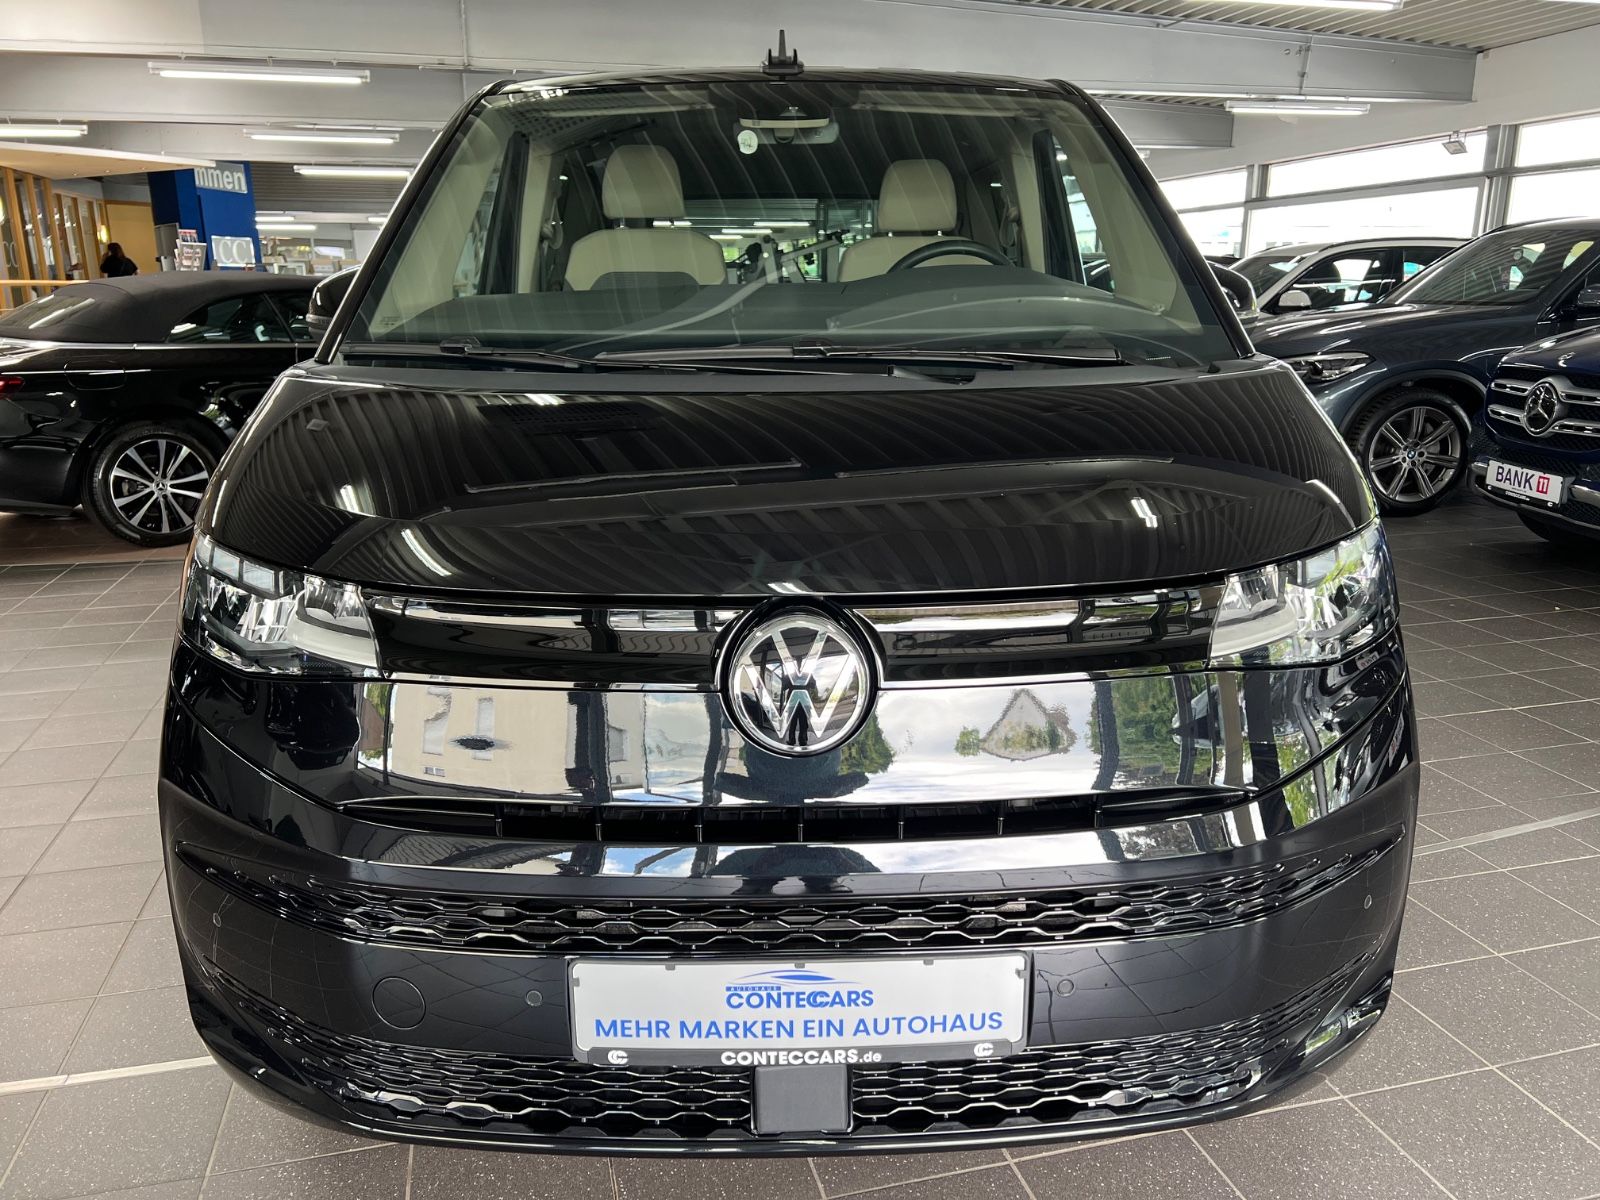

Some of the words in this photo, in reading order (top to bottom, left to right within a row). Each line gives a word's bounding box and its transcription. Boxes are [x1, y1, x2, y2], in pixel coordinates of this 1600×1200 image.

[219, 240, 248, 264] CC
[1495, 466, 1535, 491] BANK
[735, 618, 862, 745] VW
[725, 989, 875, 1009] CONTECCARS
[595, 1019, 671, 1039] MEHR
[679, 1019, 794, 1039] MARKEN
[803, 1018, 844, 1038] EIN
[852, 1011, 1003, 1037] AUTOHAUS
[720, 1049, 882, 1066] CONTECCARS.de
